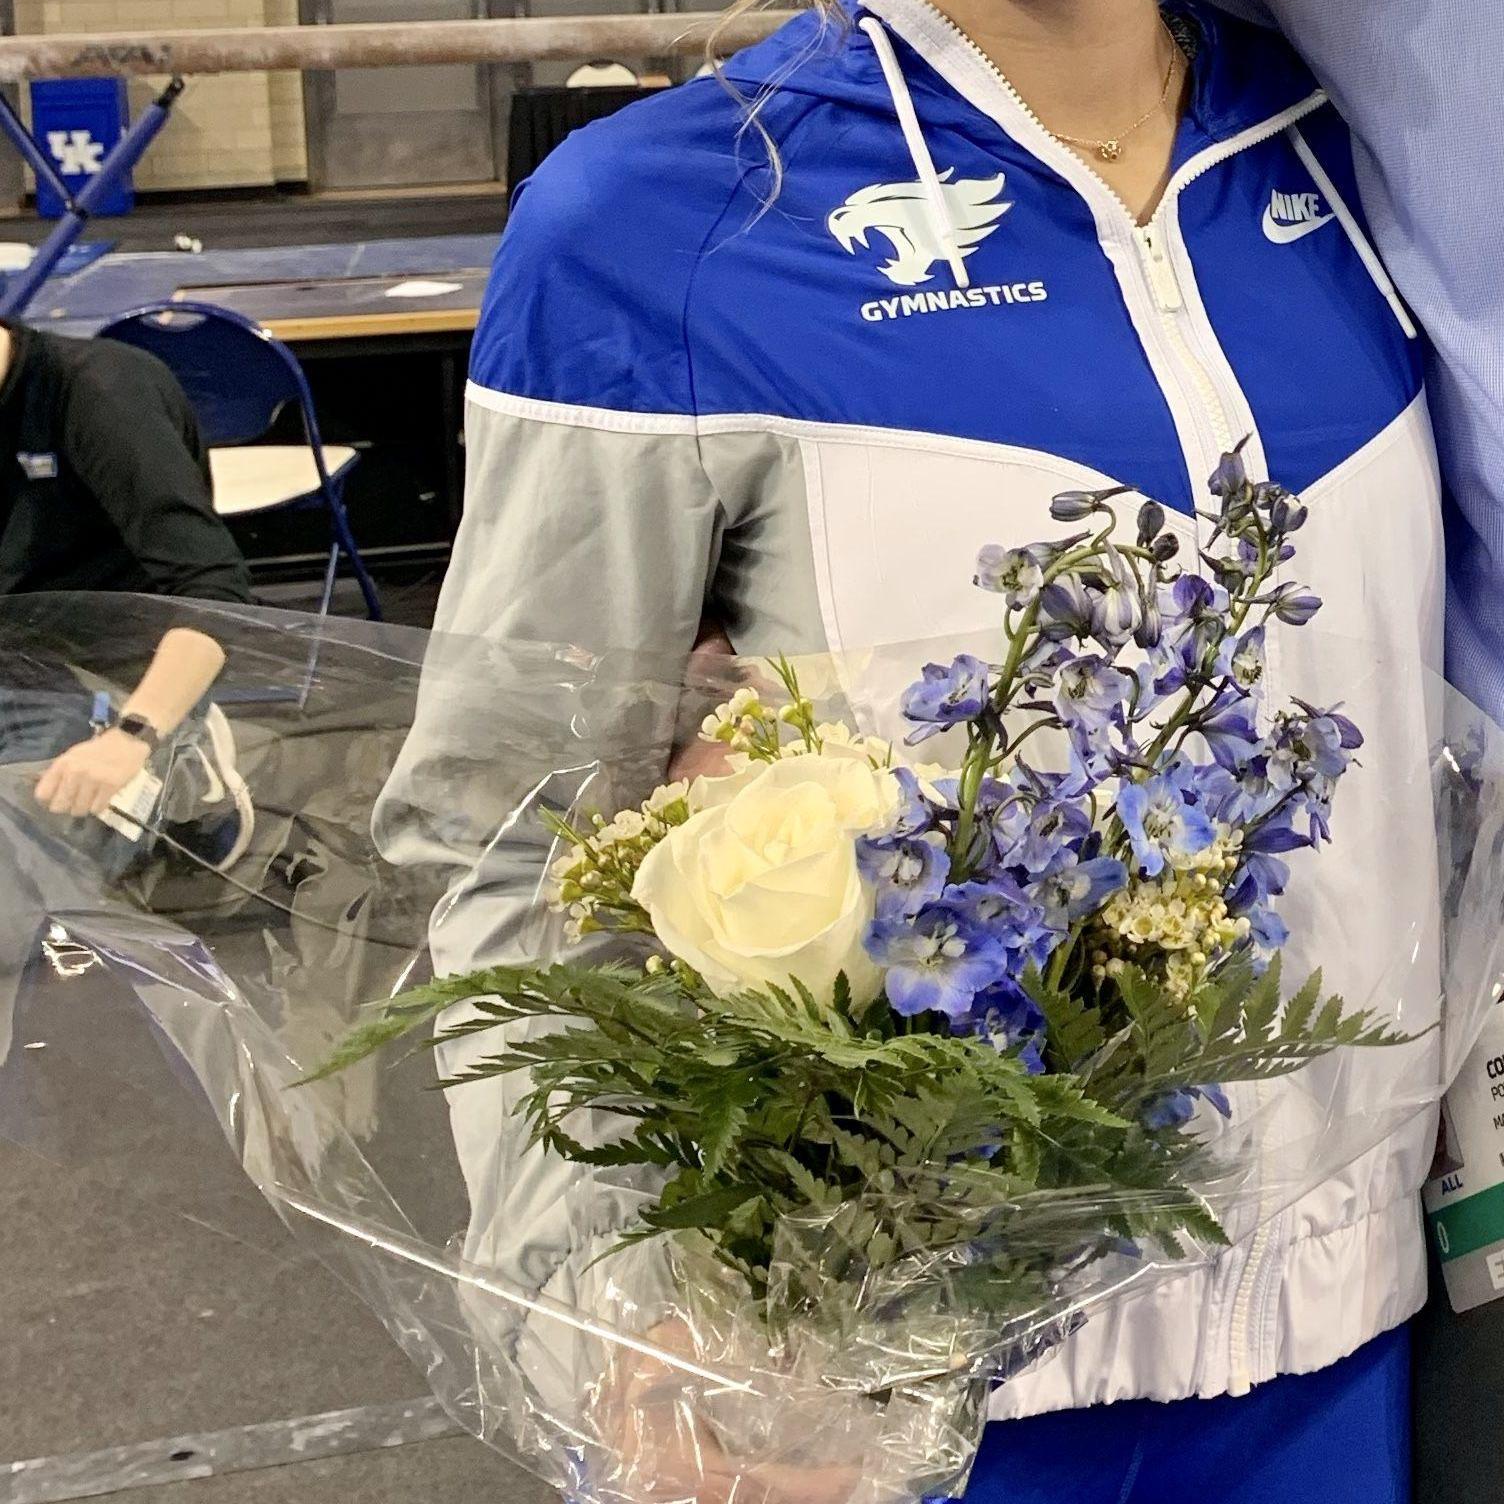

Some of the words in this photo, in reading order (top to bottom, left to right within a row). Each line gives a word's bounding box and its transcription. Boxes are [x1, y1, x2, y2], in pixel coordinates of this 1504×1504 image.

[1271, 188, 1320, 221] NIKE
[860, 282, 1048, 322] GYMNASTICS
[1441, 1174, 1463, 1195] ALL
